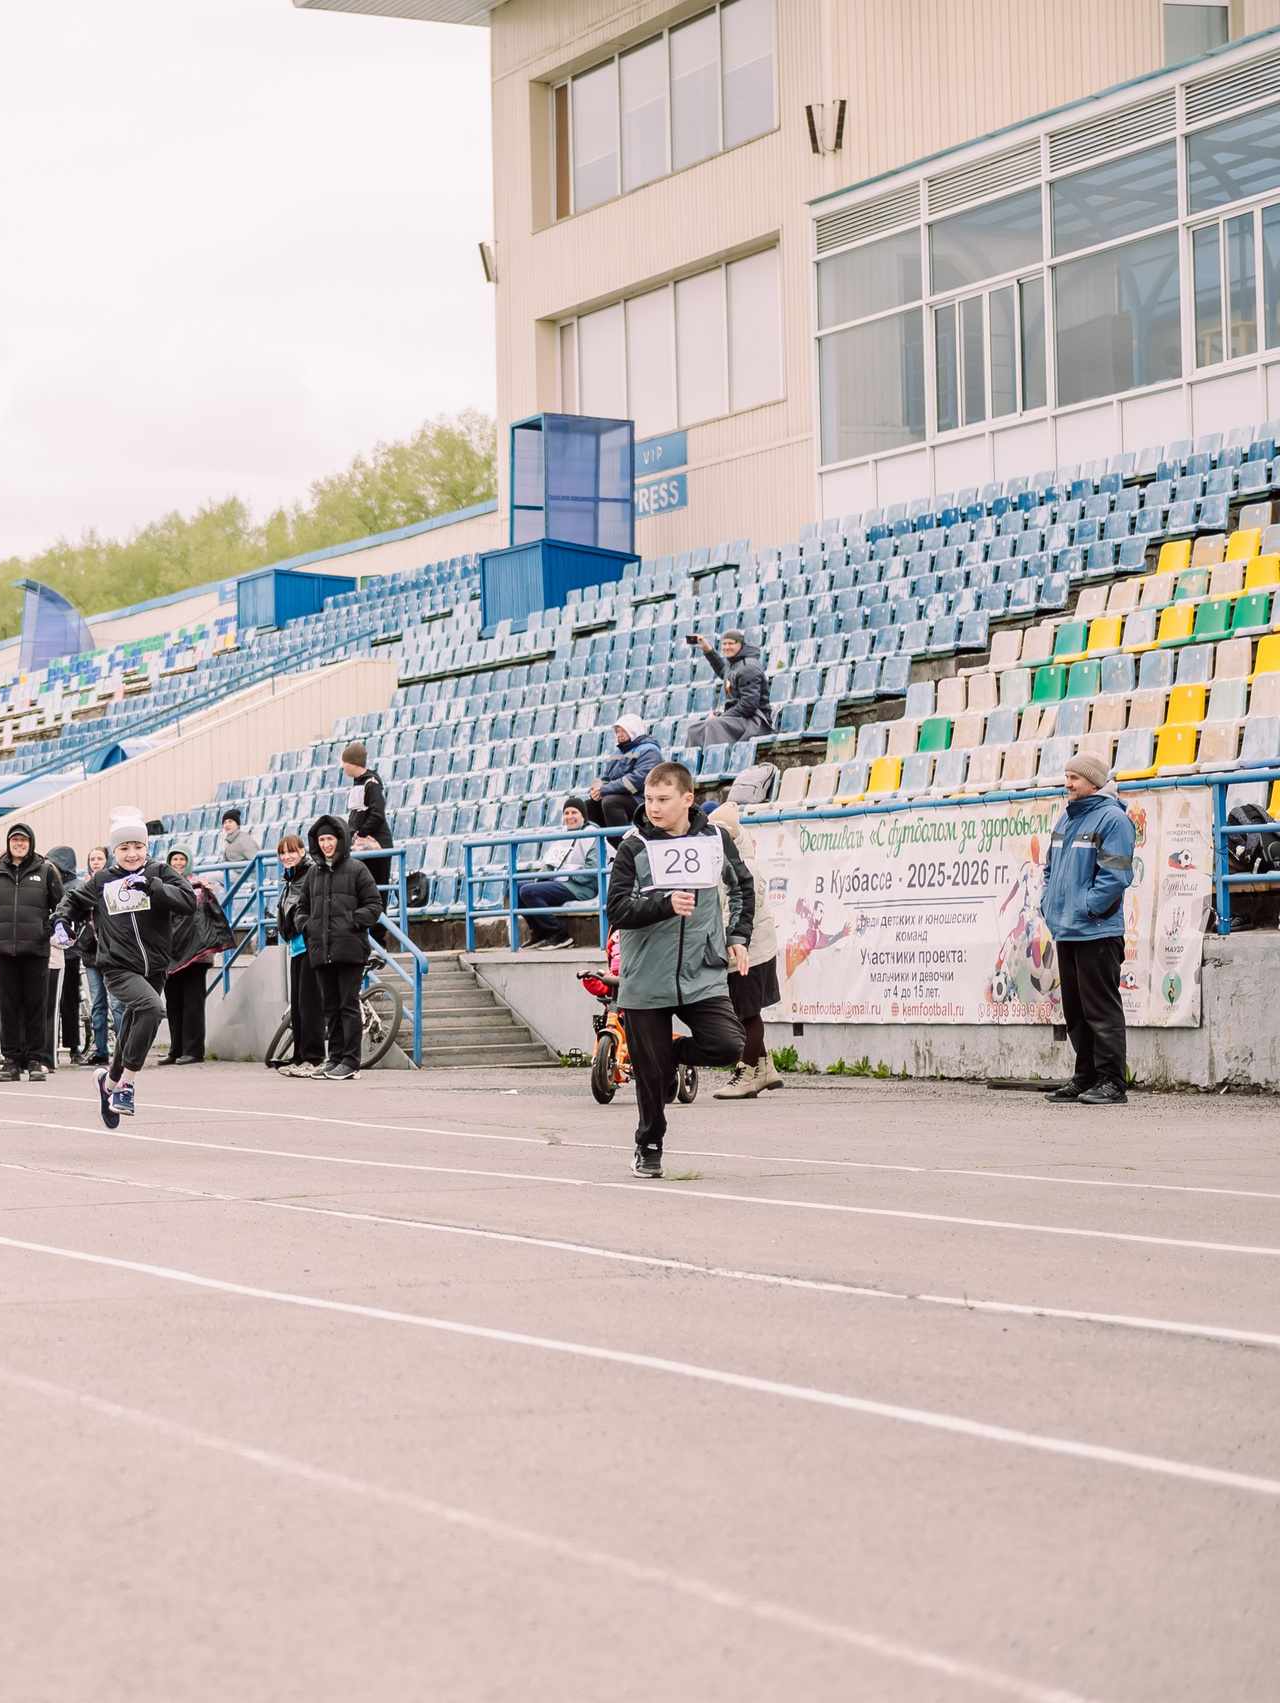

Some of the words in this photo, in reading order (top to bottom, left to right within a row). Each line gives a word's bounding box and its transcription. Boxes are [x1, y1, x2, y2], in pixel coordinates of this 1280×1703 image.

[643, 445, 663, 465] VIP
[800, 822, 864, 855] Фестиваль
[887, 816, 958, 858] футболом
[958, 819, 977, 854] за
[663, 848, 701, 875] 28
[815, 876, 825, 894] в
[830, 867, 892, 899] Кузбассе
[907, 859, 990, 888] 2025-2026
[994, 864, 1010, 885] гг.
[856, 913, 880, 930] среди
[880, 914, 916, 929] детских
[917, 915, 924, 925] и
[924, 912, 979, 925] юношеских
[895, 930, 928, 942] команд
[860, 949, 916, 966] Участники
[918, 949, 968, 968] проекта:
[870, 972, 910, 983] мальчики
[911, 972, 918, 981] и
[919, 971, 954, 984] девочки
[883, 987, 892, 999] от
[892, 985, 899, 998] 4
[900, 987, 912, 1000] до
[913, 985, 924, 998] 15
[924, 986, 941, 998] лет.
[799, 1001, 882, 1019] kemfootball@mail.ru
[902, 1001, 965, 1017] kemfootball.ru
[992, 1003, 1010, 1018] 903
[1011, 1003, 1027, 1018] 993
